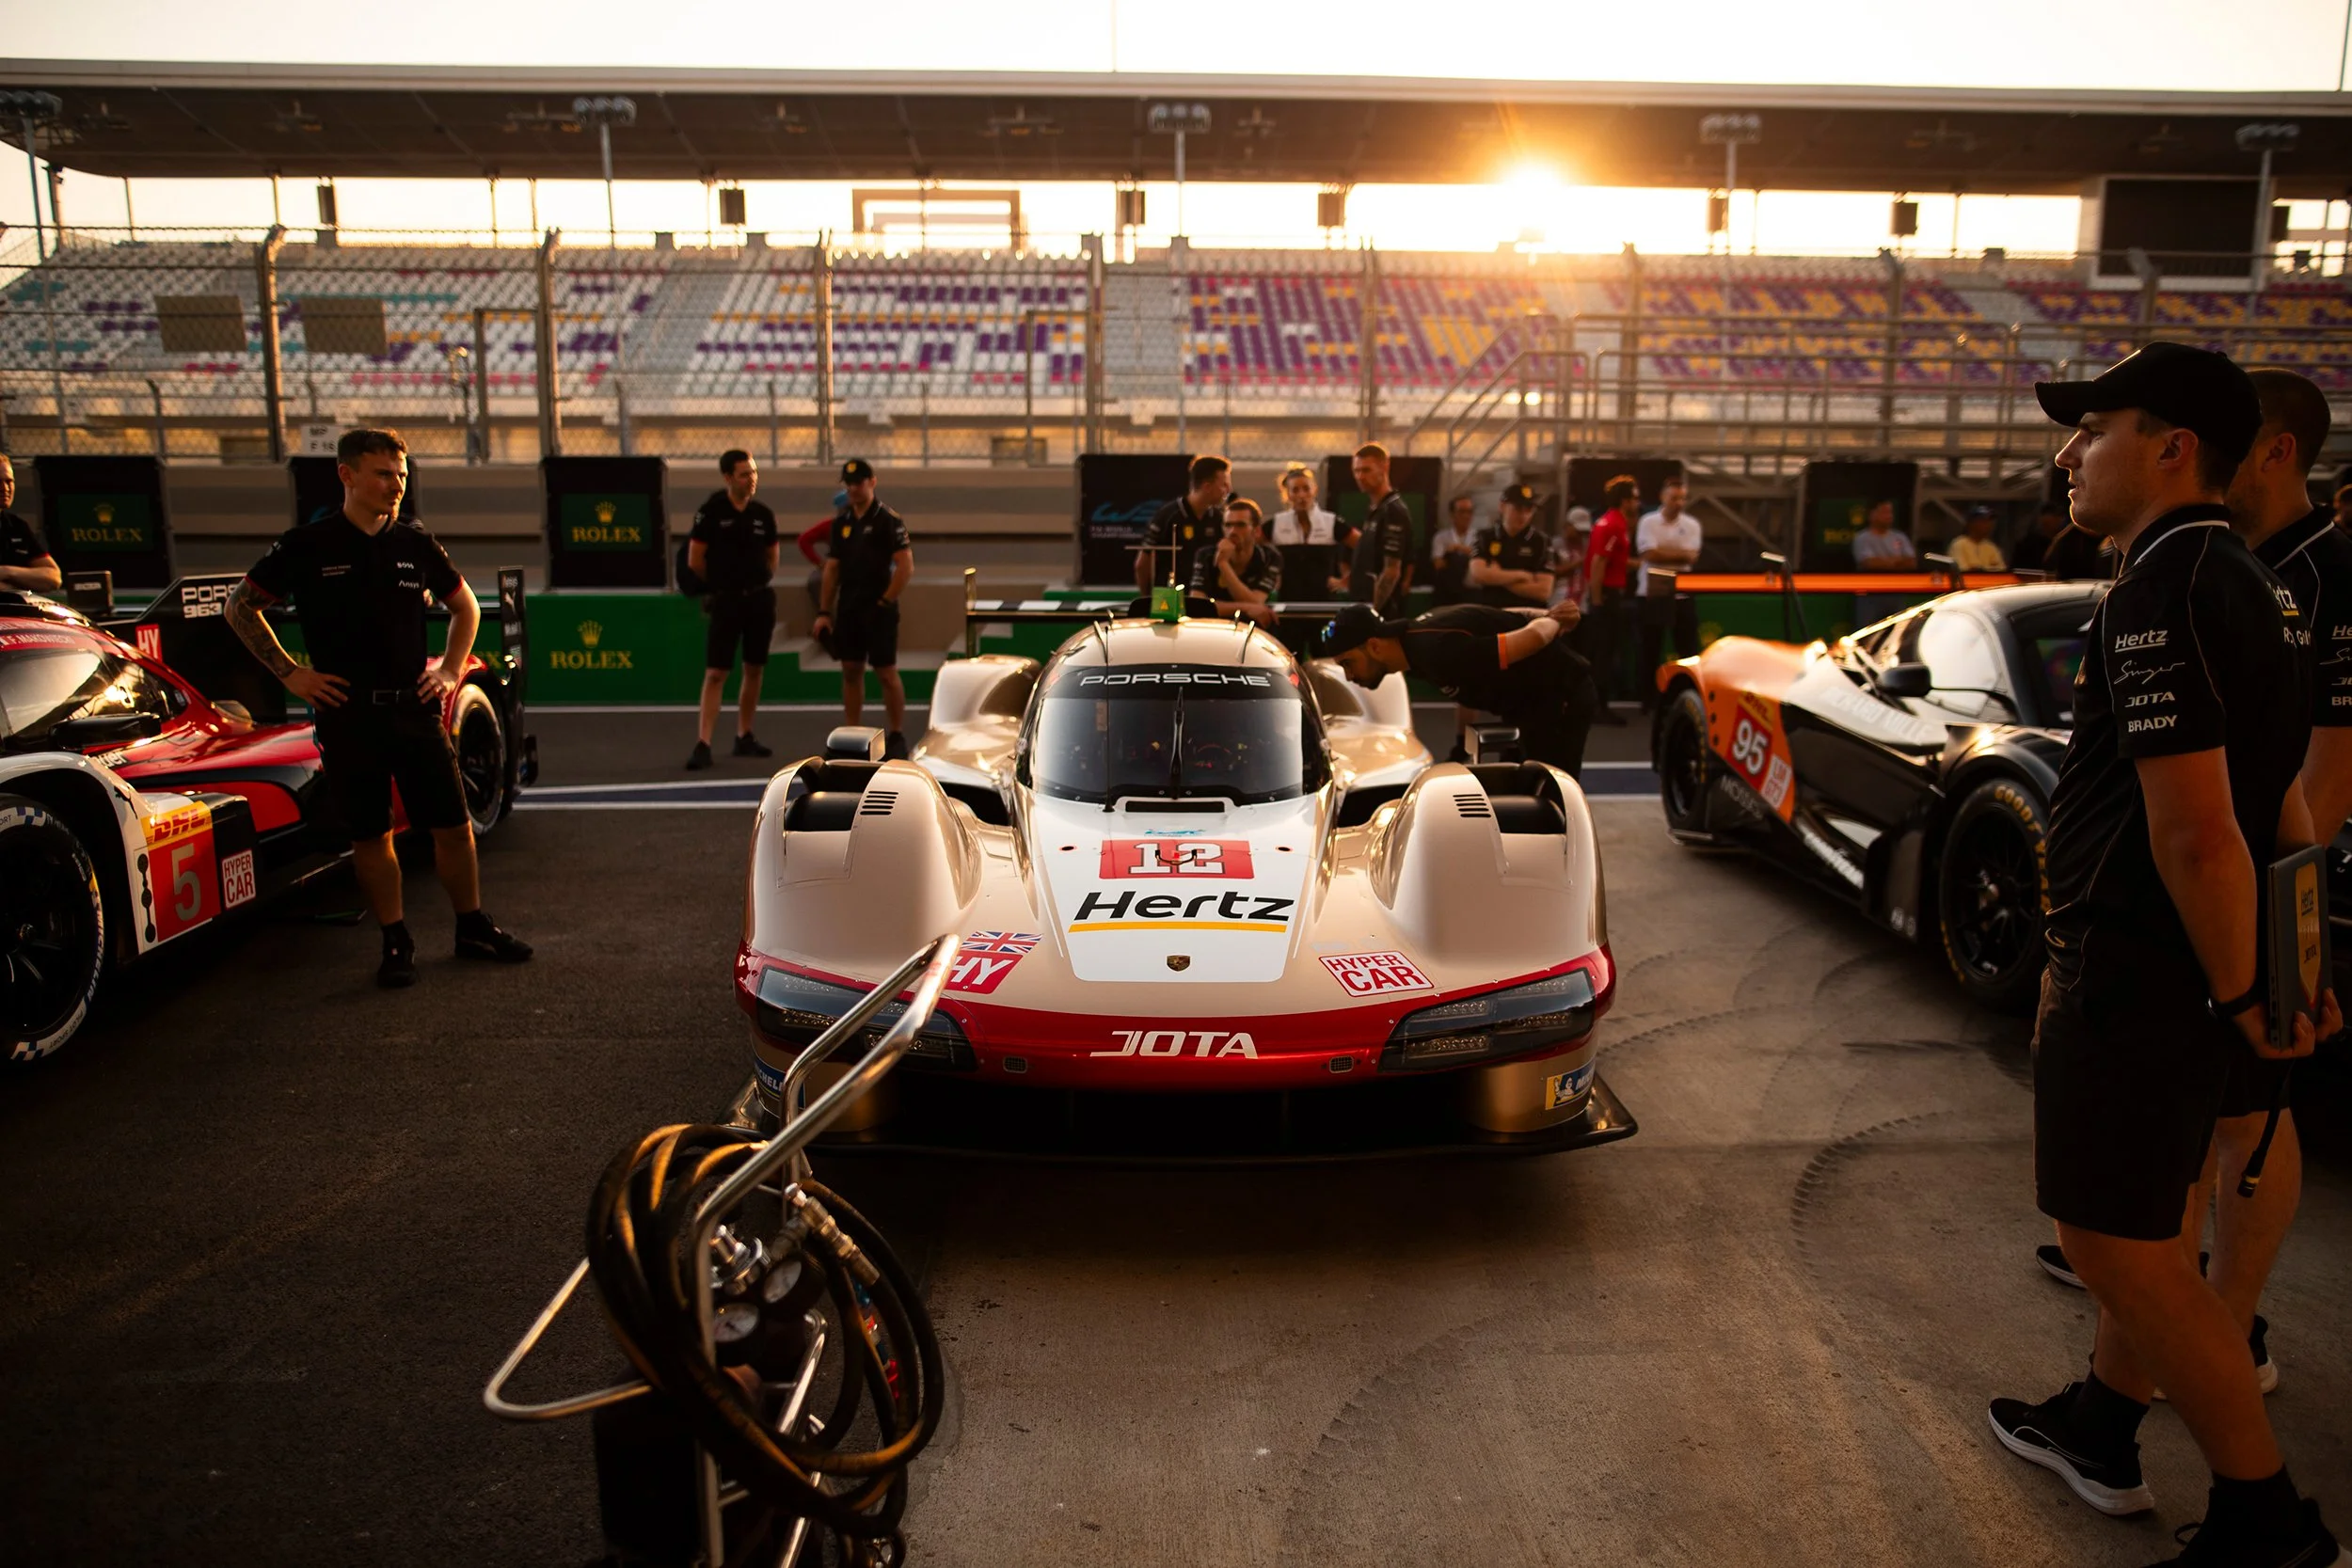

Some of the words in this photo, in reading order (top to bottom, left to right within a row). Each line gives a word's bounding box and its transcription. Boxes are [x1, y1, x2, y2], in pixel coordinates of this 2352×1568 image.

[72, 528, 143, 543] ROLEX
[571, 525, 642, 543] ROLEX
[183, 602, 223, 619] 963
[137, 628, 158, 659] HY
[2115, 628, 2169, 649] Hertz
[549, 650, 633, 669] ROLEX
[2114, 659, 2185, 685] Singer
[1080, 673, 1271, 687] PORSCHE
[2124, 690, 2176, 707] JOTA
[2127, 714, 2178, 733] BRADY
[1732, 719, 1768, 775] 95
[0, 815, 11, 825] ORT
[151, 809, 205, 843] DHL
[224, 854, 252, 879] HYPER
[1129, 842, 1226, 875] 12
[171, 843, 201, 921] 5
[226, 872, 254, 904] CAR
[1073, 891, 1295, 922] Hertz
[951, 956, 1015, 985] HY
[1327, 954, 1405, 972] HYPER
[1341, 966, 1426, 992] CAR
[1089, 1030, 1259, 1059] JOTA
